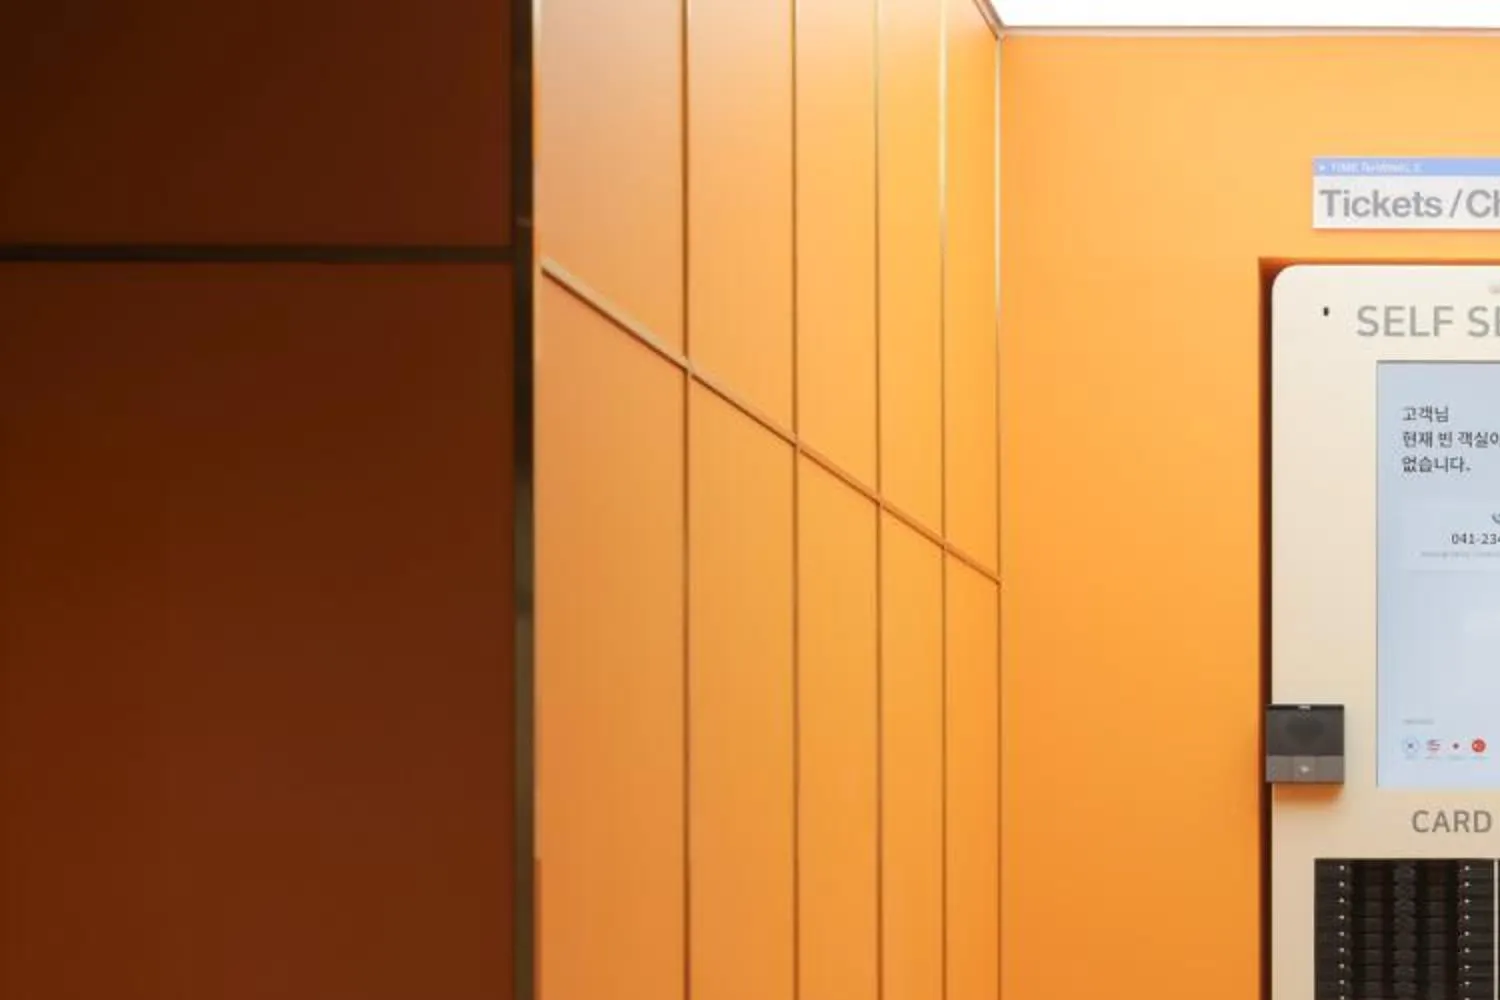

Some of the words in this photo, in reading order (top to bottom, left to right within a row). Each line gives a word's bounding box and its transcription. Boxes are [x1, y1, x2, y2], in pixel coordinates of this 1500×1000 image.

[1318, 188, 1444, 219] Tickets
[1356, 304, 1454, 338] SELF
[1402, 405, 1449, 424] 고객님
[1402, 431, 1433, 449] 현재
[1437, 431, 1453, 449] 빈
[1401, 455, 1471, 473] 없습니다.
[1411, 809, 1492, 834] CARD
